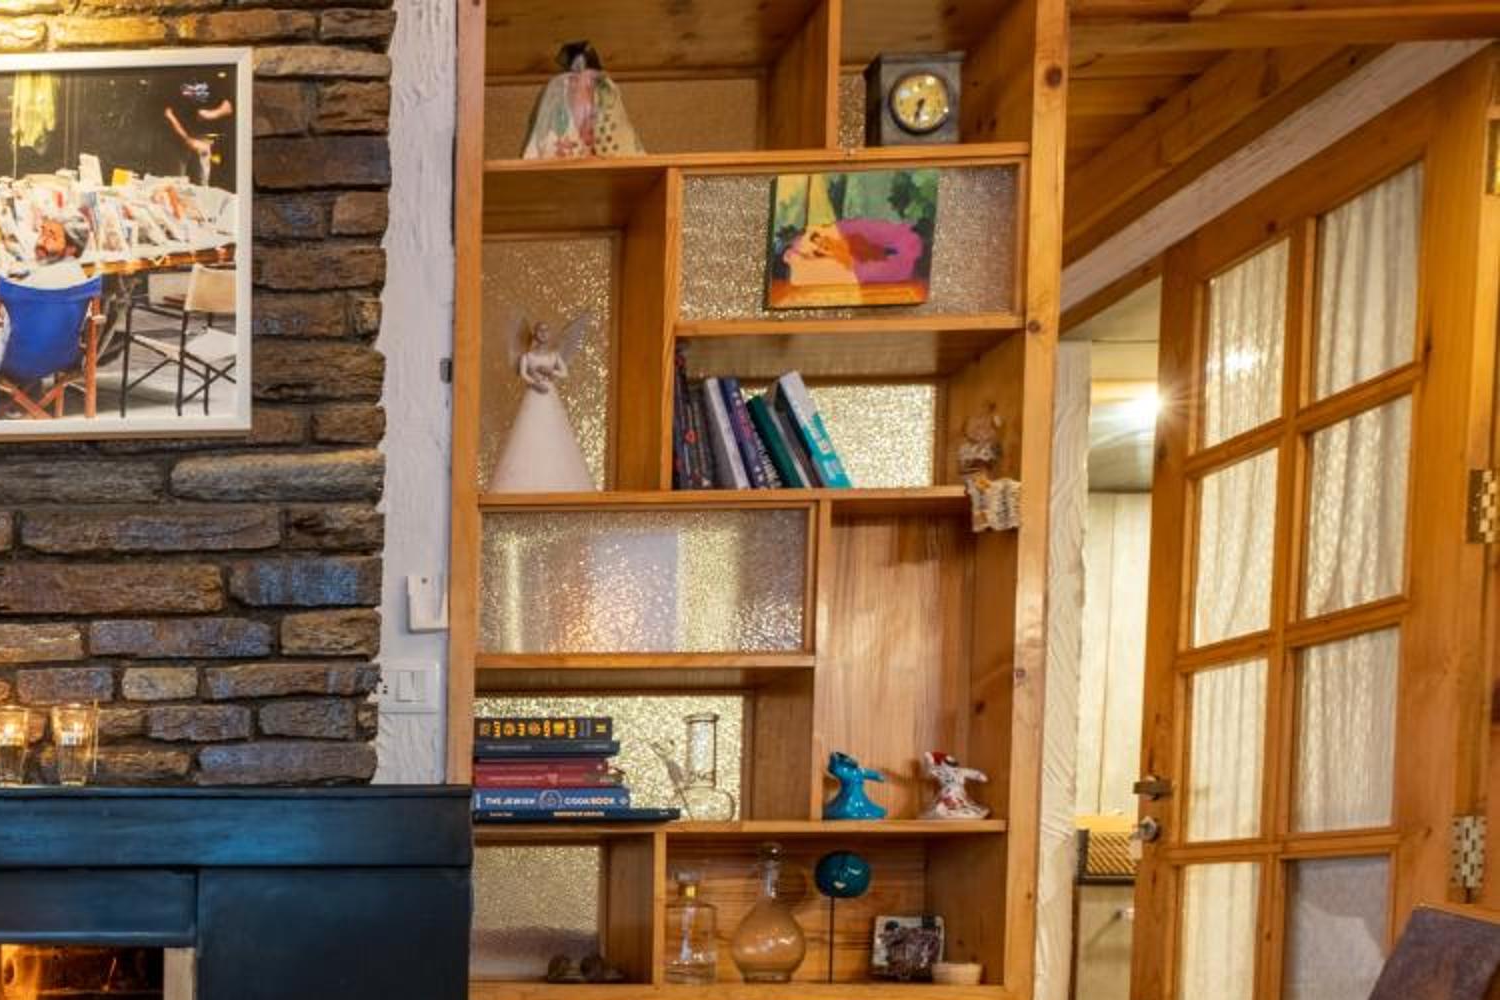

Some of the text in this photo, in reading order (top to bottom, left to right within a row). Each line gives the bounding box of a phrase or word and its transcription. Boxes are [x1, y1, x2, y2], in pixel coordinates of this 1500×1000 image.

[484, 797, 501, 805] THE
[502, 797, 536, 805] JEWISH
[564, 796, 614, 805] COOKBOOK
